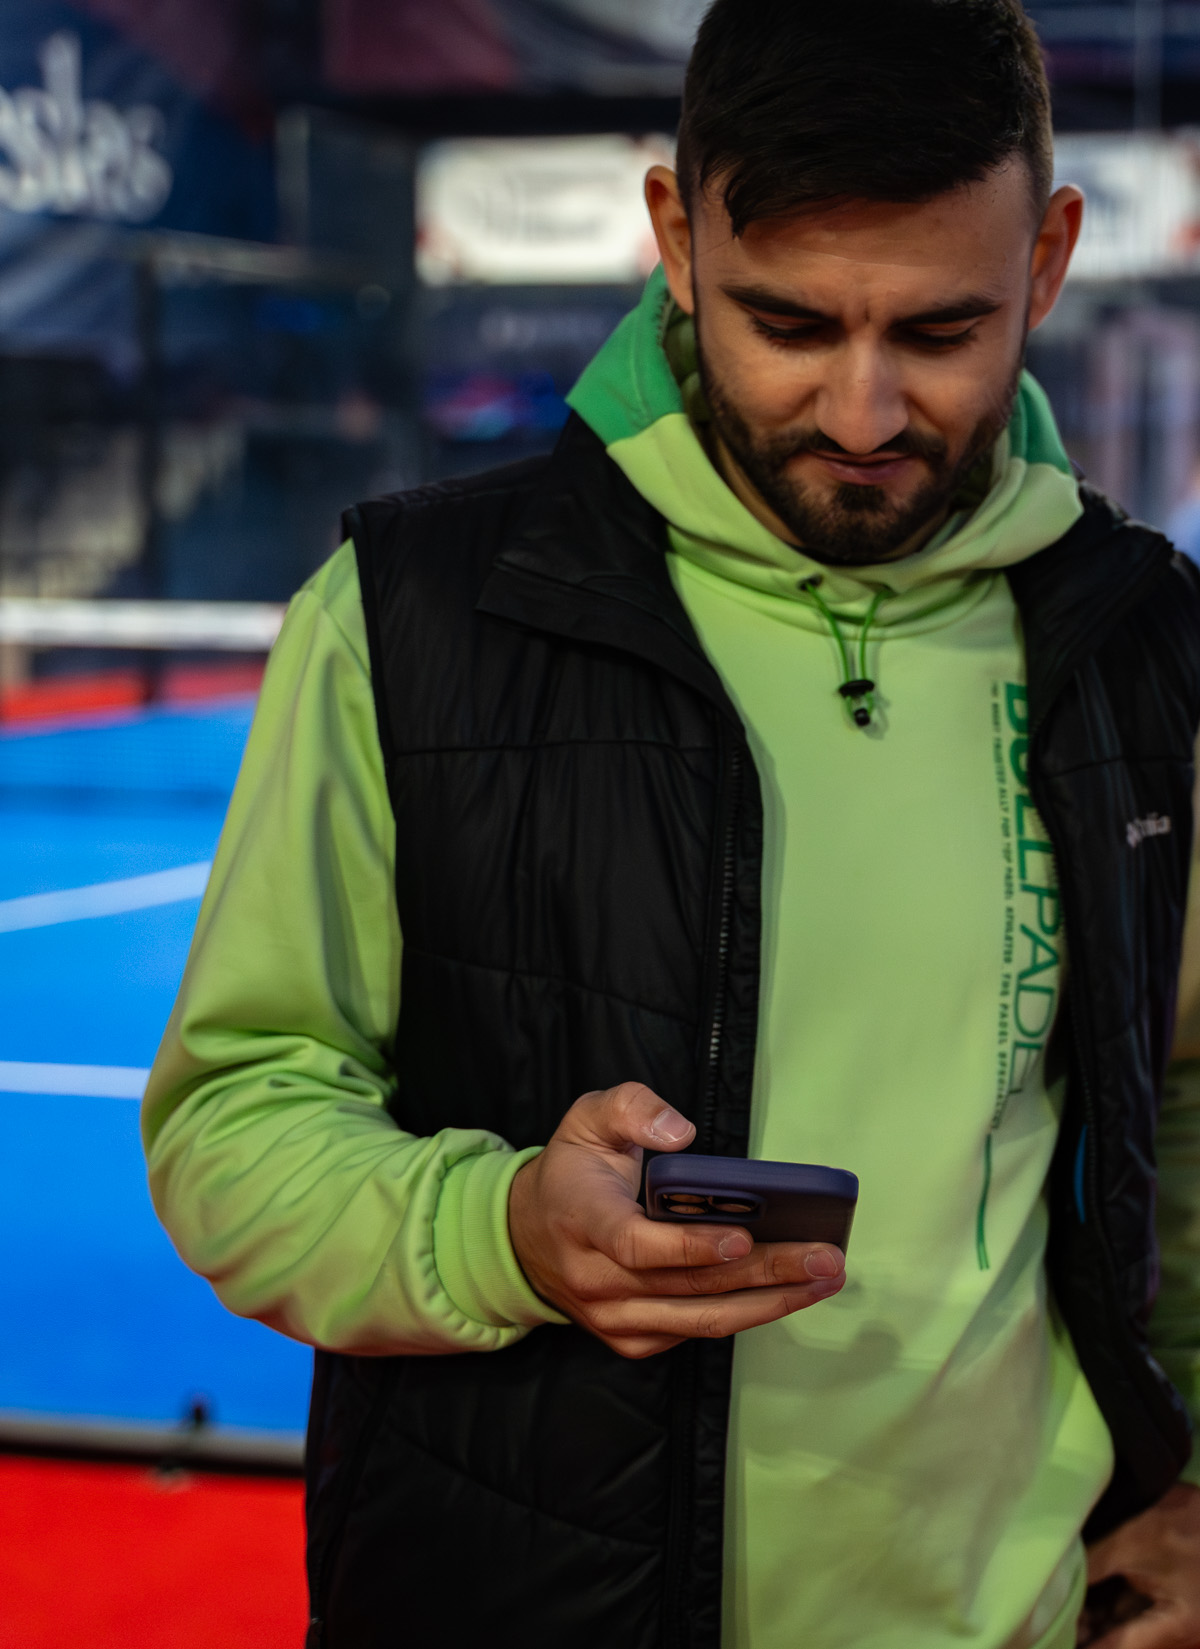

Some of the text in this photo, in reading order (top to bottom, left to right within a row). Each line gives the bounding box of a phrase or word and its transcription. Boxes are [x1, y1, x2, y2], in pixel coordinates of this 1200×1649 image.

[993, 737, 1006, 784] TRUSTED
[999, 786, 1009, 813] ALLY
[1001, 817, 1011, 838] FOR
[1002, 842, 1012, 863] TOP
[1003, 866, 1014, 900] PADEL
[1000, 973, 1012, 996] THE
[998, 1003, 1009, 1045] PADEL
